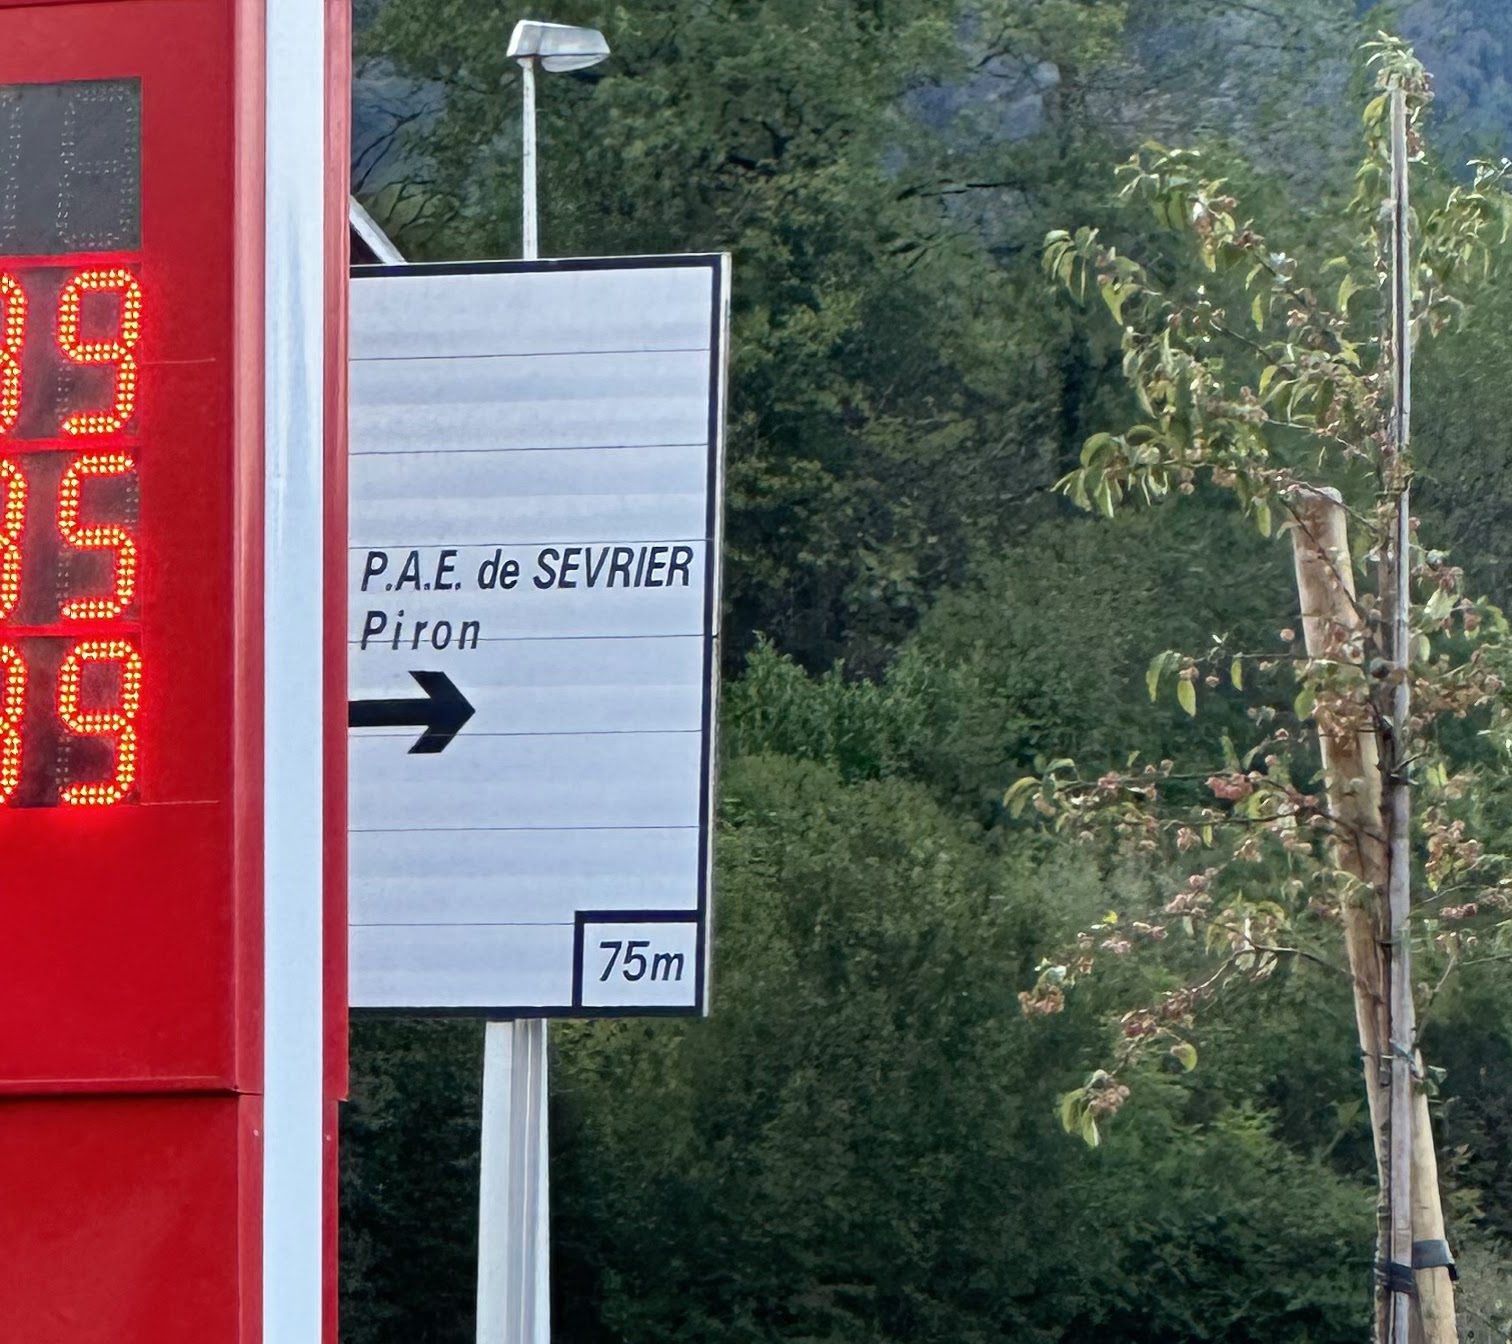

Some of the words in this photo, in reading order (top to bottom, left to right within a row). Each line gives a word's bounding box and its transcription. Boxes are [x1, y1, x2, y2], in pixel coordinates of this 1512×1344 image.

[360, 550, 461, 592] P.A.E.
[477, 548, 520, 590] de
[532, 546, 694, 590] SEVRIER
[360, 610, 480, 651] Piron
[599, 940, 684, 982] 75m
